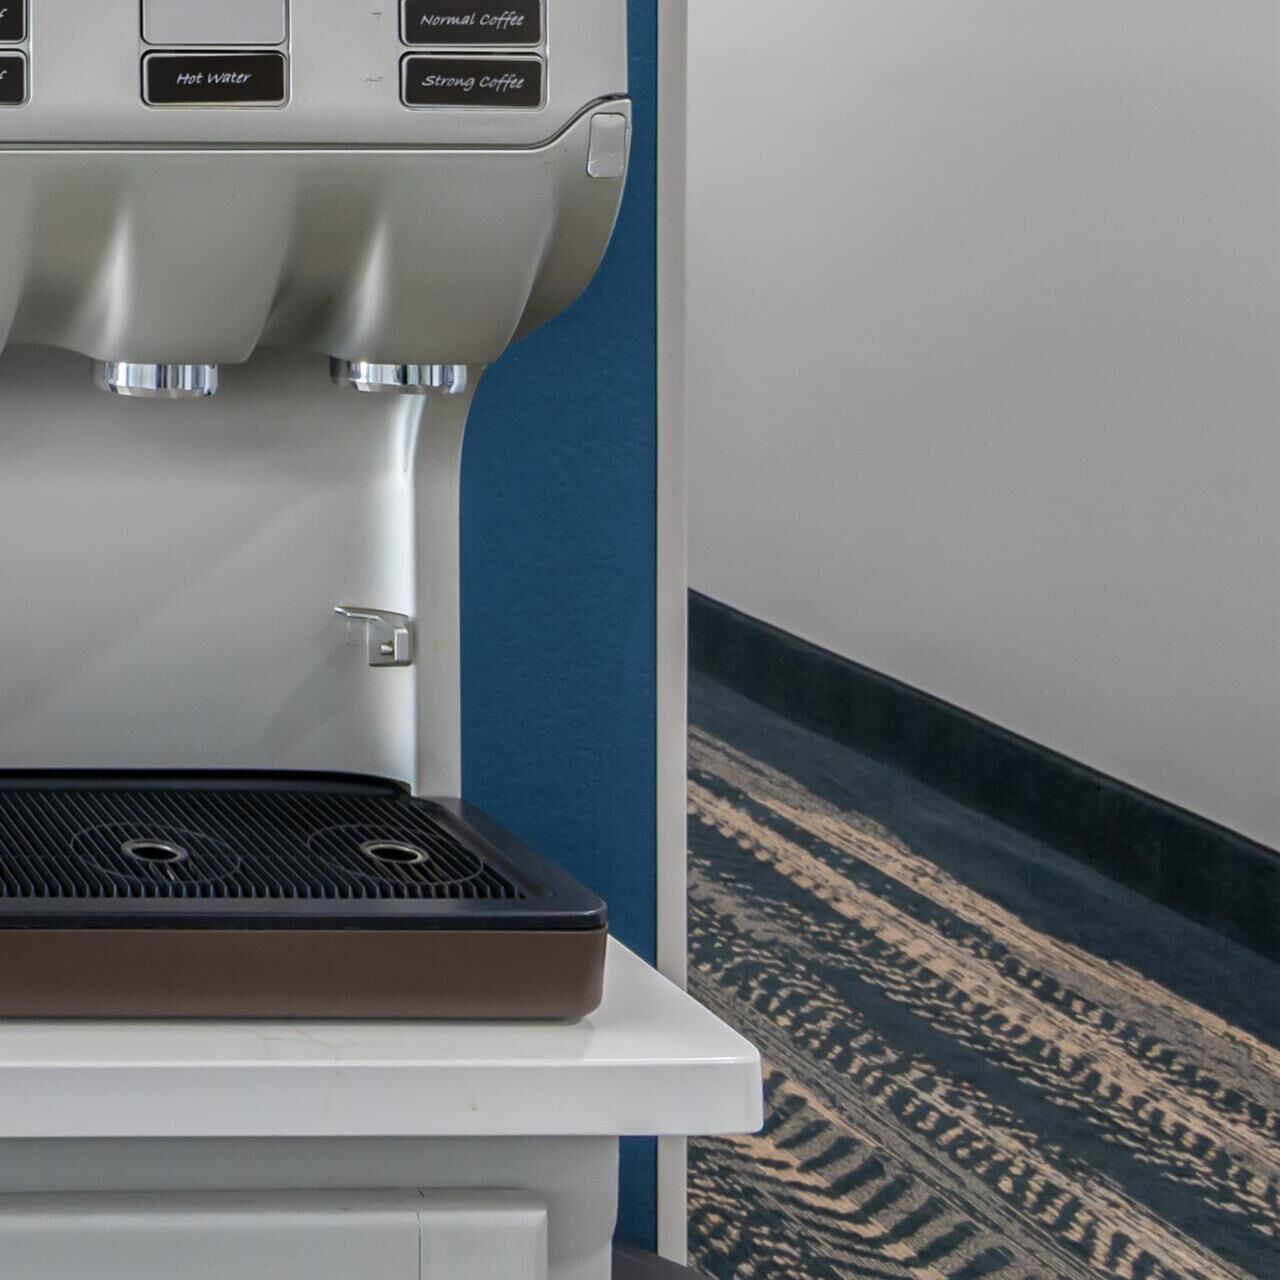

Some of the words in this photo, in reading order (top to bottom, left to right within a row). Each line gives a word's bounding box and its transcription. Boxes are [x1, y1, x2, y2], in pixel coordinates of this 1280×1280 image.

[420, 12, 475, 26] Normal
[479, 10, 525, 30] Coffee
[176, 72, 203, 85] Hot
[207, 71, 252, 84] Water
[421, 75, 475, 92] Strong
[479, 73, 525, 93] Coffee
